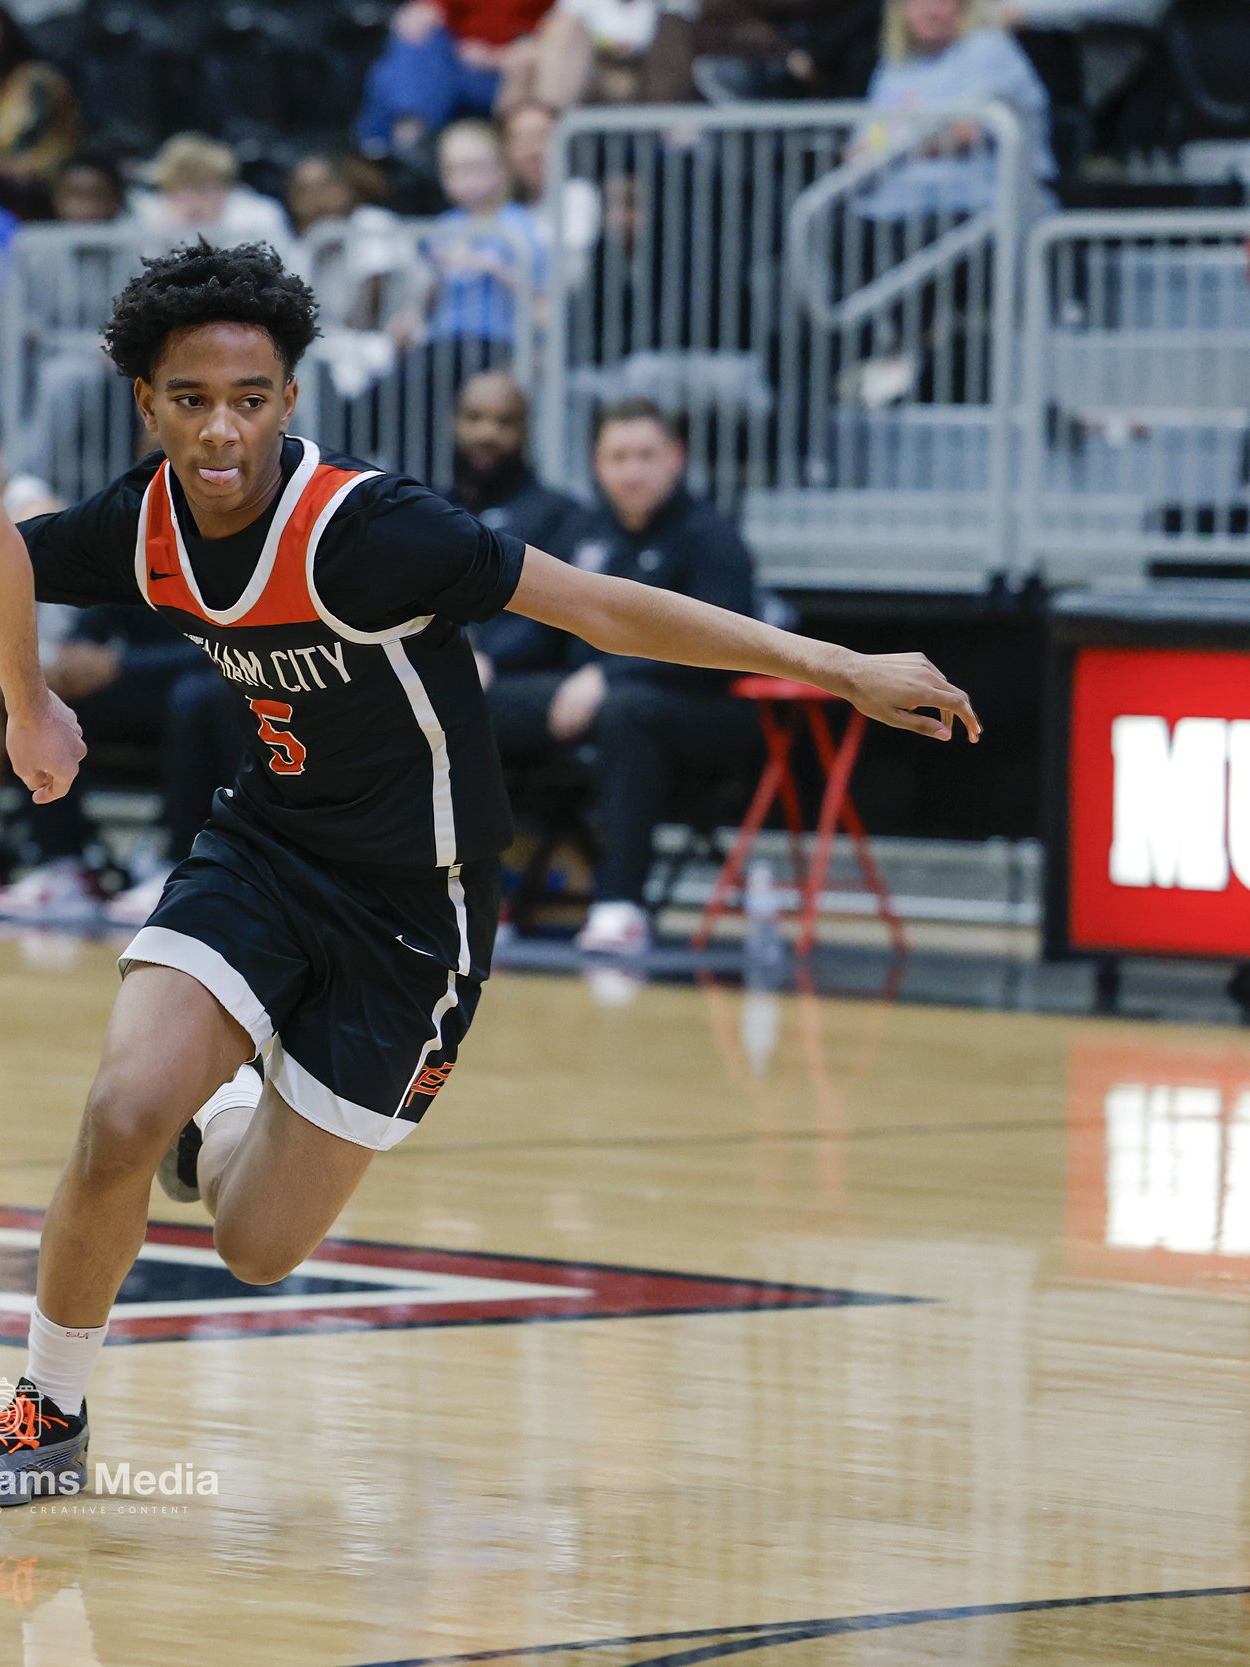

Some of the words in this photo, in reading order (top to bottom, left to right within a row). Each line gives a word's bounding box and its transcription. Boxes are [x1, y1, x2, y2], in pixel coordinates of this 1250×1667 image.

[269, 641, 352, 693] CITY
[245, 695, 307, 776] 5
[1108, 714, 1250, 892] M
